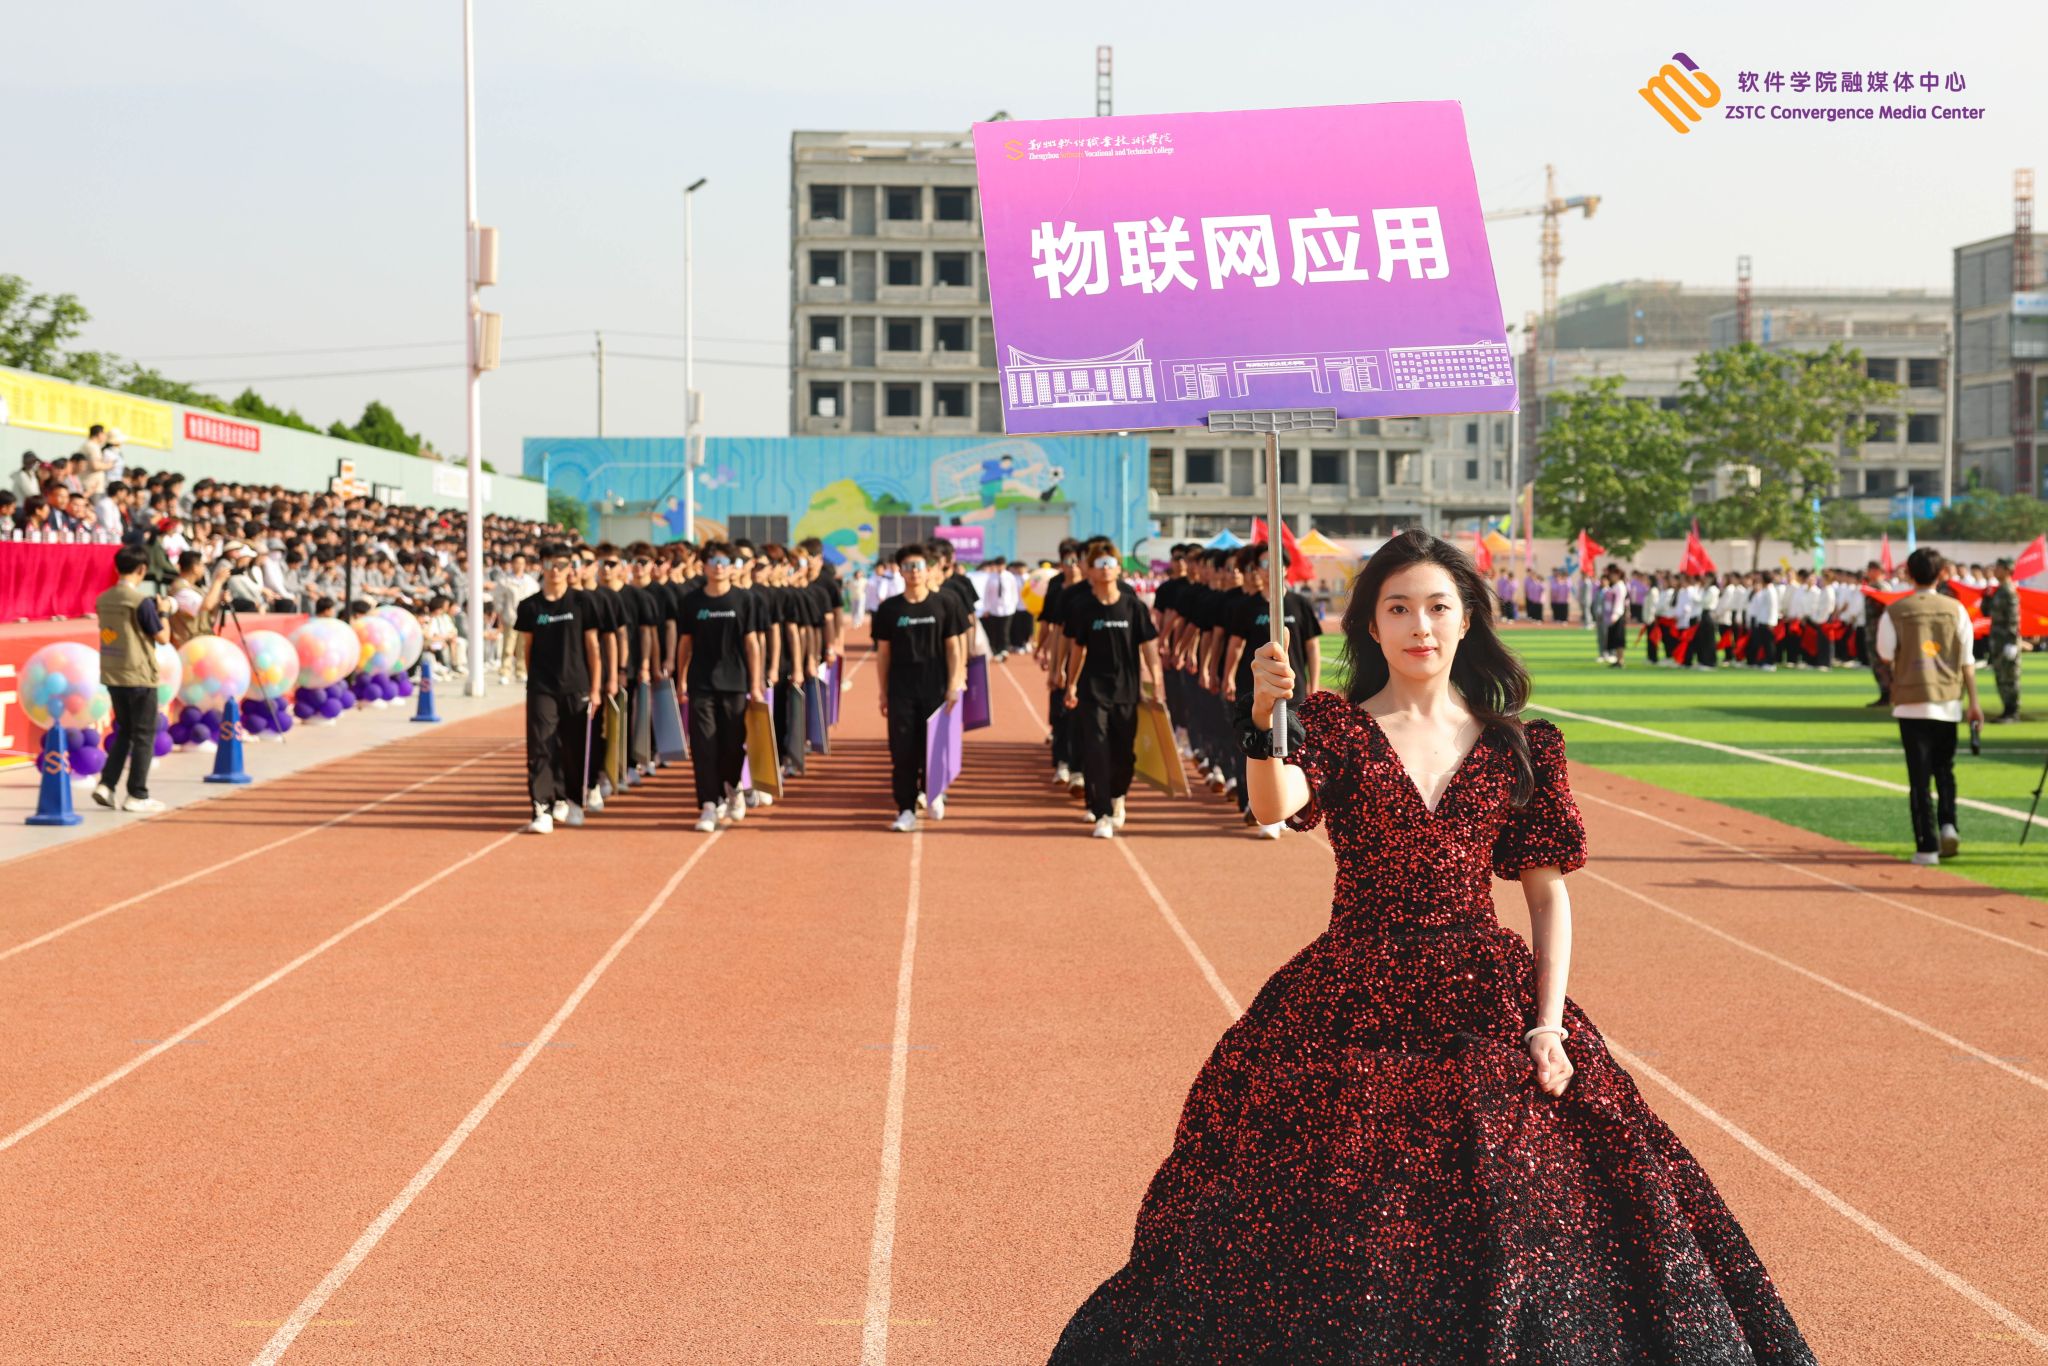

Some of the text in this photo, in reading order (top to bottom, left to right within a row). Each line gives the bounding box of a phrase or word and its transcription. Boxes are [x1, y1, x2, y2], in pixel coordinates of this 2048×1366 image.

[1084, 149, 1114, 158] Vocational
[1114, 148, 1127, 156] and
[1127, 146, 1153, 156] Technical
[1153, 145, 1174, 156] College
[1030, 206, 1450, 299] 物联网应用
